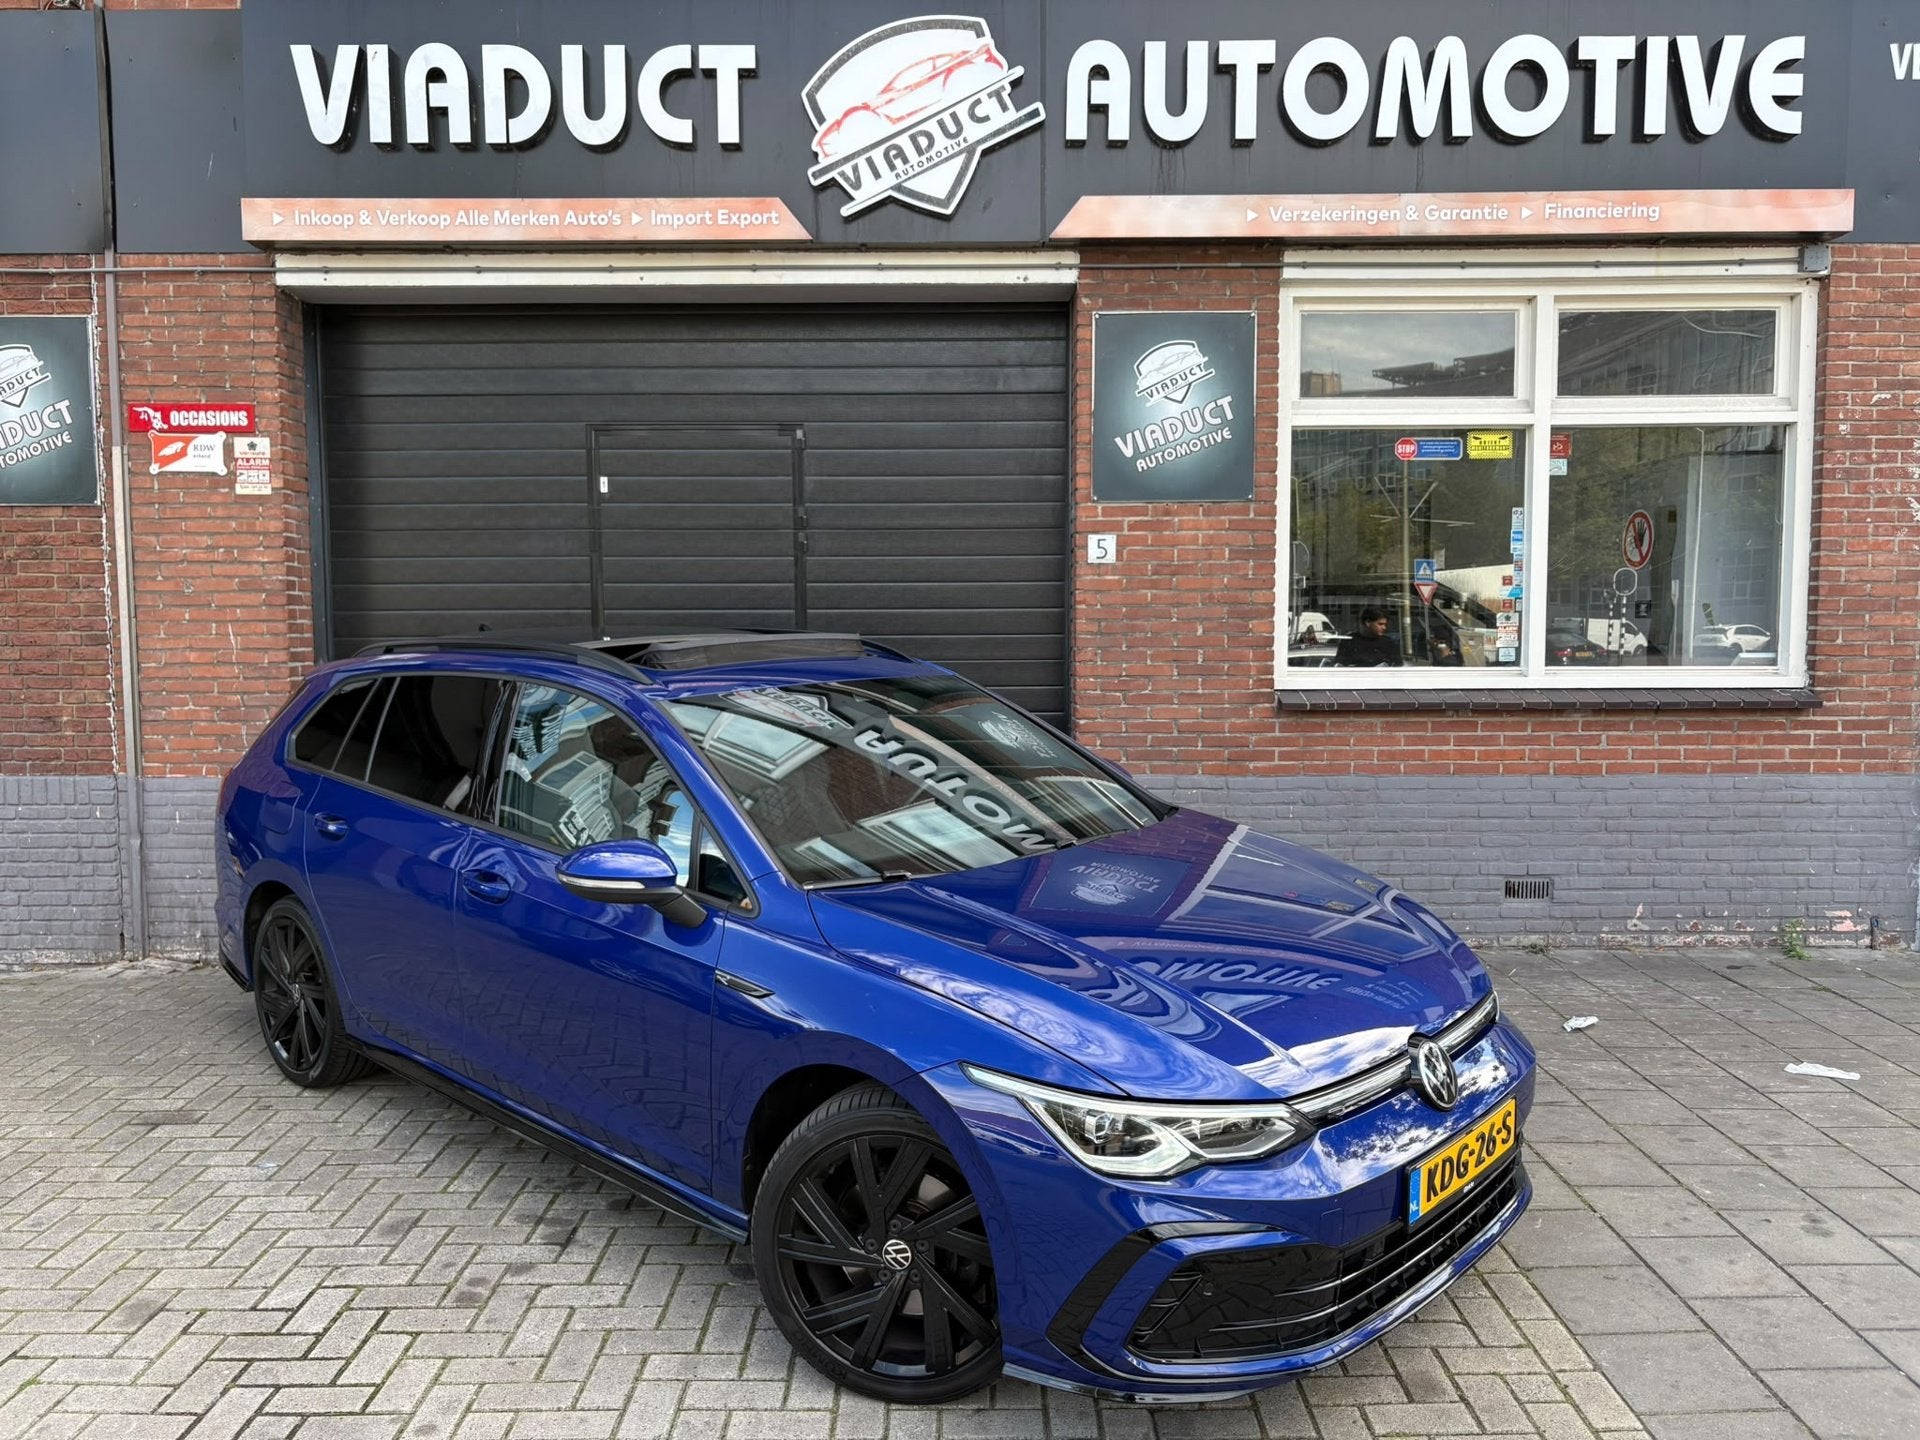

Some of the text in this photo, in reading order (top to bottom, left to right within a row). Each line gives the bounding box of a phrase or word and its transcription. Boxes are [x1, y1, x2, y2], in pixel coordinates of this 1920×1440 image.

[289, 42, 757, 146] VIADUCT
[1065, 32, 1807, 142] AUTOMOTIVE
[837, 84, 1010, 191] VIADUCT
[895, 136, 969, 180] AUTOMOTIVE
[295, 209, 354, 229] Inkoop
[359, 209, 372, 226] &
[376, 209, 451, 229] Verkoop
[455, 209, 489, 226] Alle
[494, 210, 560, 226] Merken
[651, 209, 779, 229] Import Export
[1269, 204, 1508, 225] Verzekeringen & Garantie
[1545, 202, 1660, 222] Financiering
[1146, 363, 1206, 399] VIADUCT
[170, 410, 249, 427] OCCASIONS
[1114, 395, 1235, 458] VIADUCT
[193, 443, 216, 452] RDW
[1136, 427, 1233, 472] AUTOMOTIVE
[1397, 444, 1416, 453] STOP
[237, 458, 270, 467] ALARM
[1096, 538, 1109, 560] 5
[1426, 1109, 1512, 1203] KDG-26-S
[1409, 1202, 1418, 1213] NL
